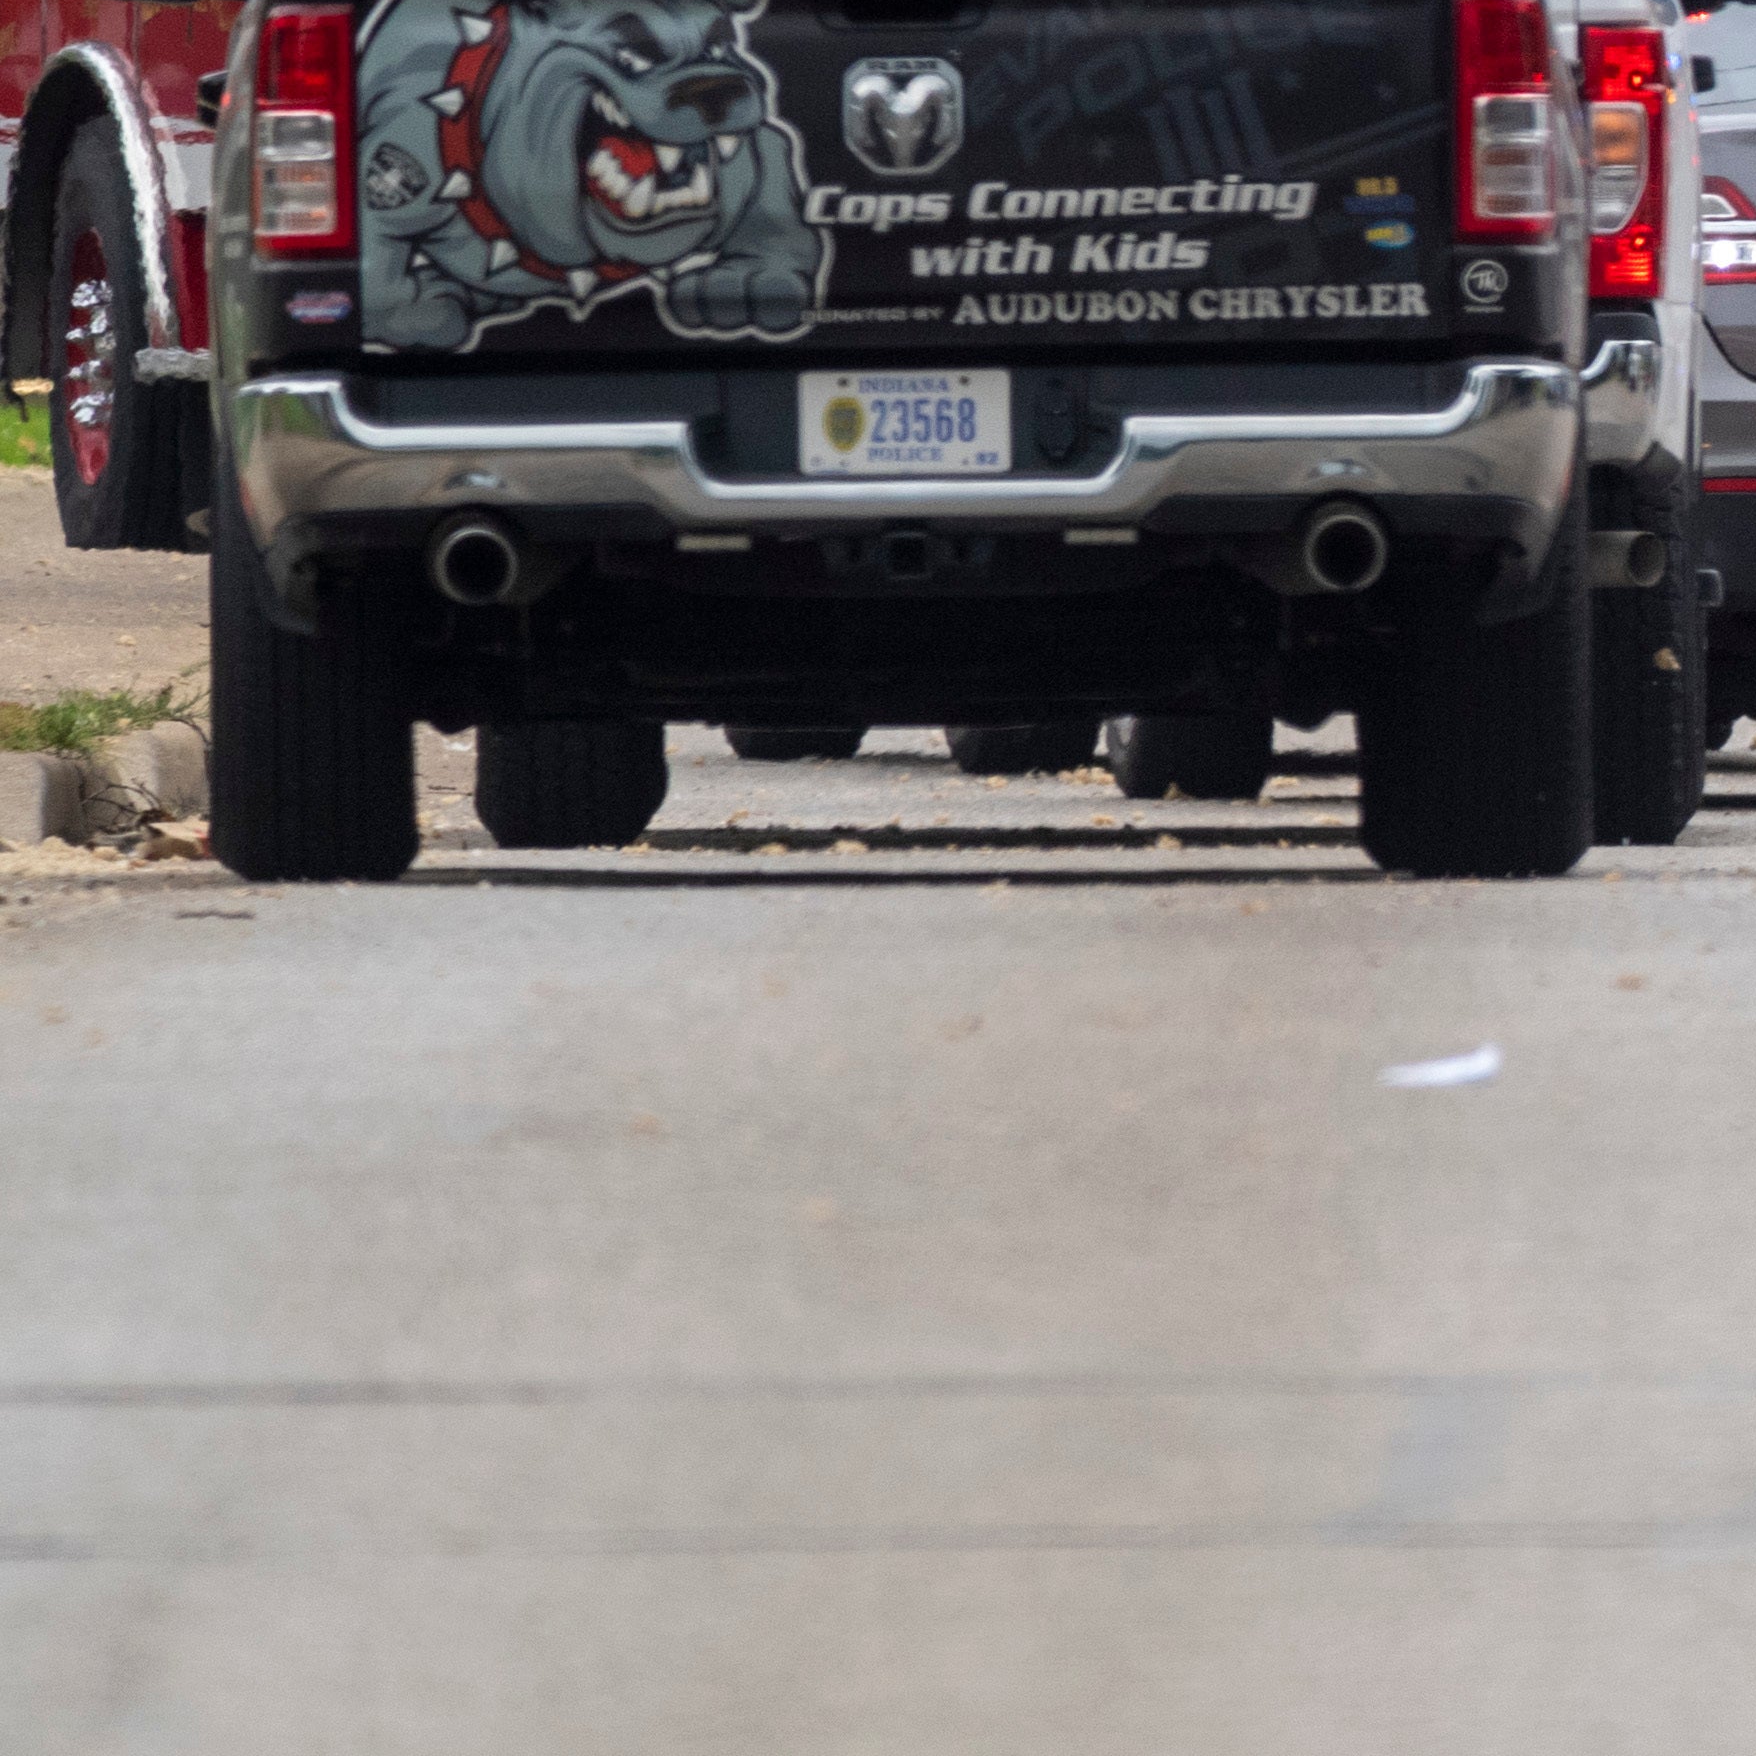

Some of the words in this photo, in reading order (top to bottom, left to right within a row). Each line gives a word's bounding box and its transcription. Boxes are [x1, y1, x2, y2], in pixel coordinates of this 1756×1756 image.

[804, 185, 951, 233] Cops
[966, 174, 1319, 222] Connecting
[910, 236, 1053, 277] with
[1070, 232, 1211, 273] Kids
[952, 289, 1180, 325] AUDUBON
[1188, 282, 1431, 320] CHRYSLER
[858, 377, 949, 394] INDIANA
[870, 397, 977, 444] 23568
